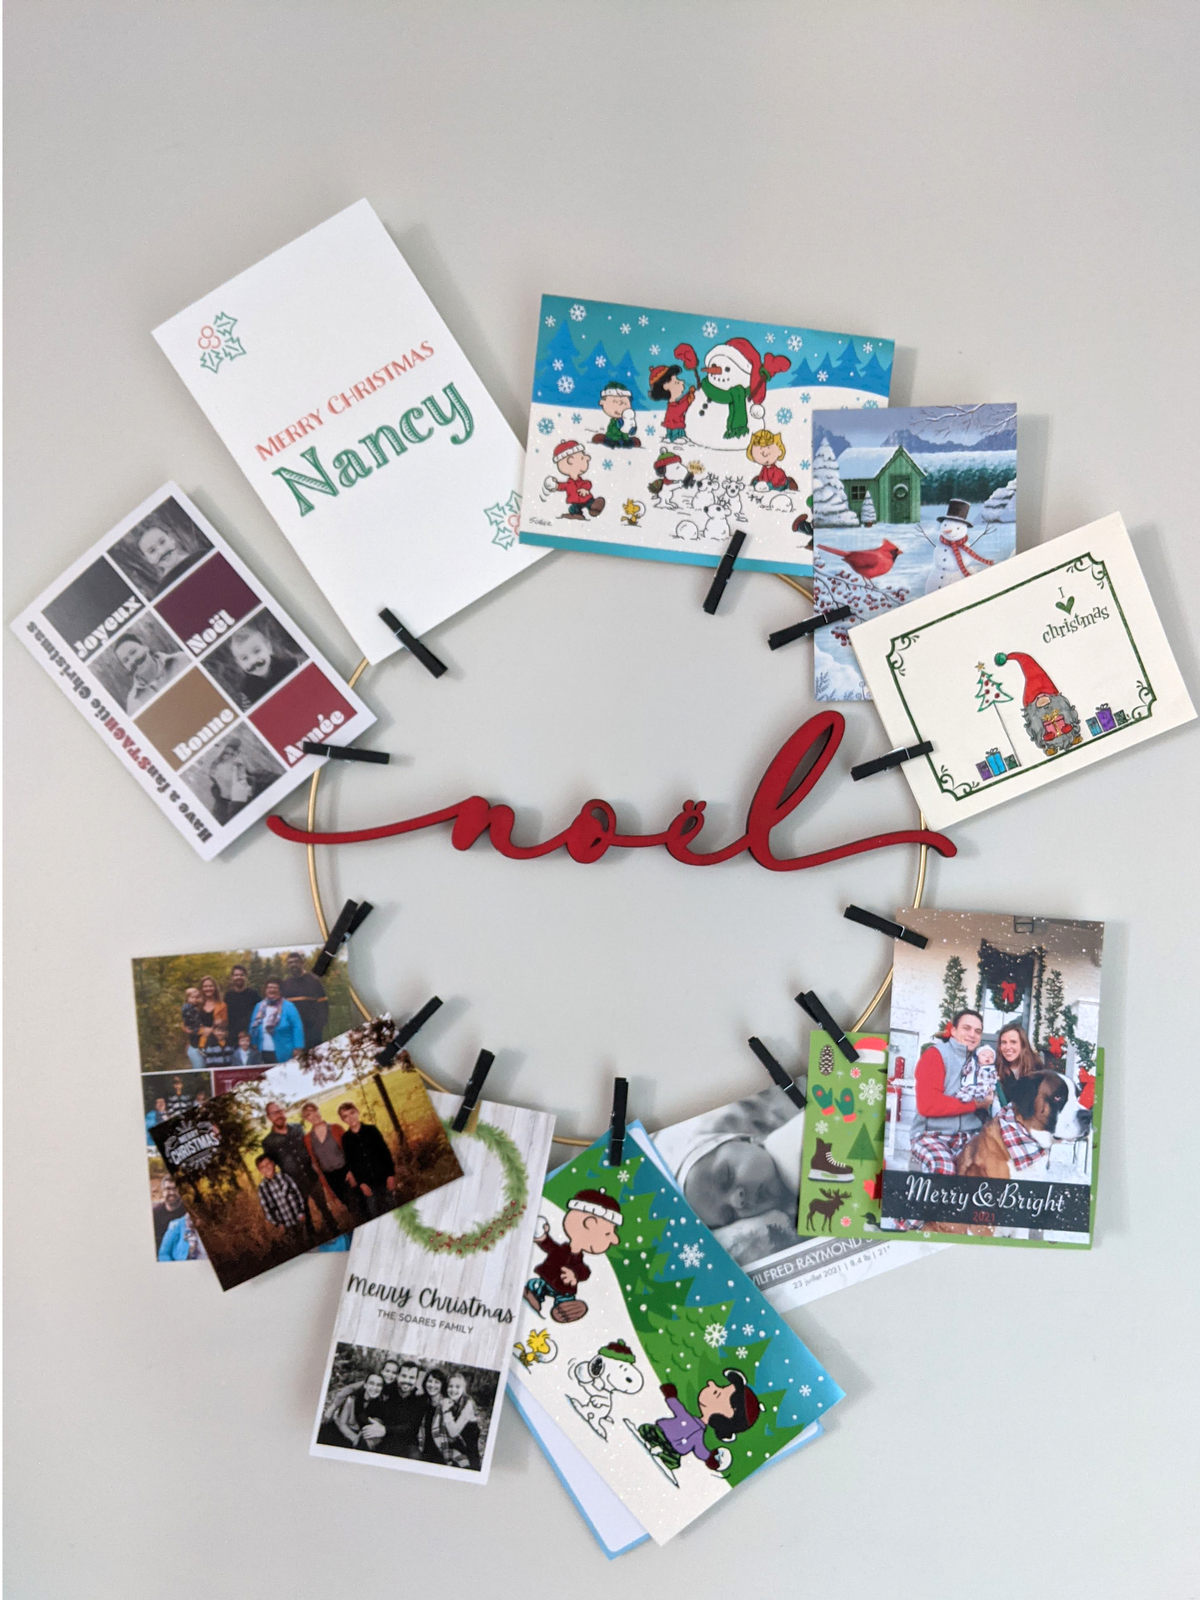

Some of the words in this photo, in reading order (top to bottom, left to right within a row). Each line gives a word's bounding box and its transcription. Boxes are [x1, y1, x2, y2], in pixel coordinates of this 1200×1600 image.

[254, 408, 324, 462] MERRY
[327, 340, 434, 416] CHRISTMAS
[271, 382, 475, 518] Nancy
[1057, 586, 1065, 598] I
[73, 595, 144, 659] Joyeux
[185, 608, 236, 655] Noël
[1042, 606, 1110, 644] christmas
[26, 621, 91, 700] Christmas
[172, 706, 235, 762] Bonne
[169, 790, 181, 803] a
[178, 803, 214, 844] Have
[170, 1132, 220, 1166] CHRISTMAS
[906, 1174, 969, 1212] Merry
[997, 1182, 1065, 1217] Bright
[972, 1210, 995, 1223] 2021
[346, 1273, 413, 1308] Merry
[419, 1287, 516, 1324] Christmas
[792, 1280, 803, 1290] 23
[823, 1266, 843, 1280] 2021
[377, 1308, 400, 1320] THE
[399, 1313, 437, 1328] SOARES
[438, 1320, 474, 1335] FAMILY
